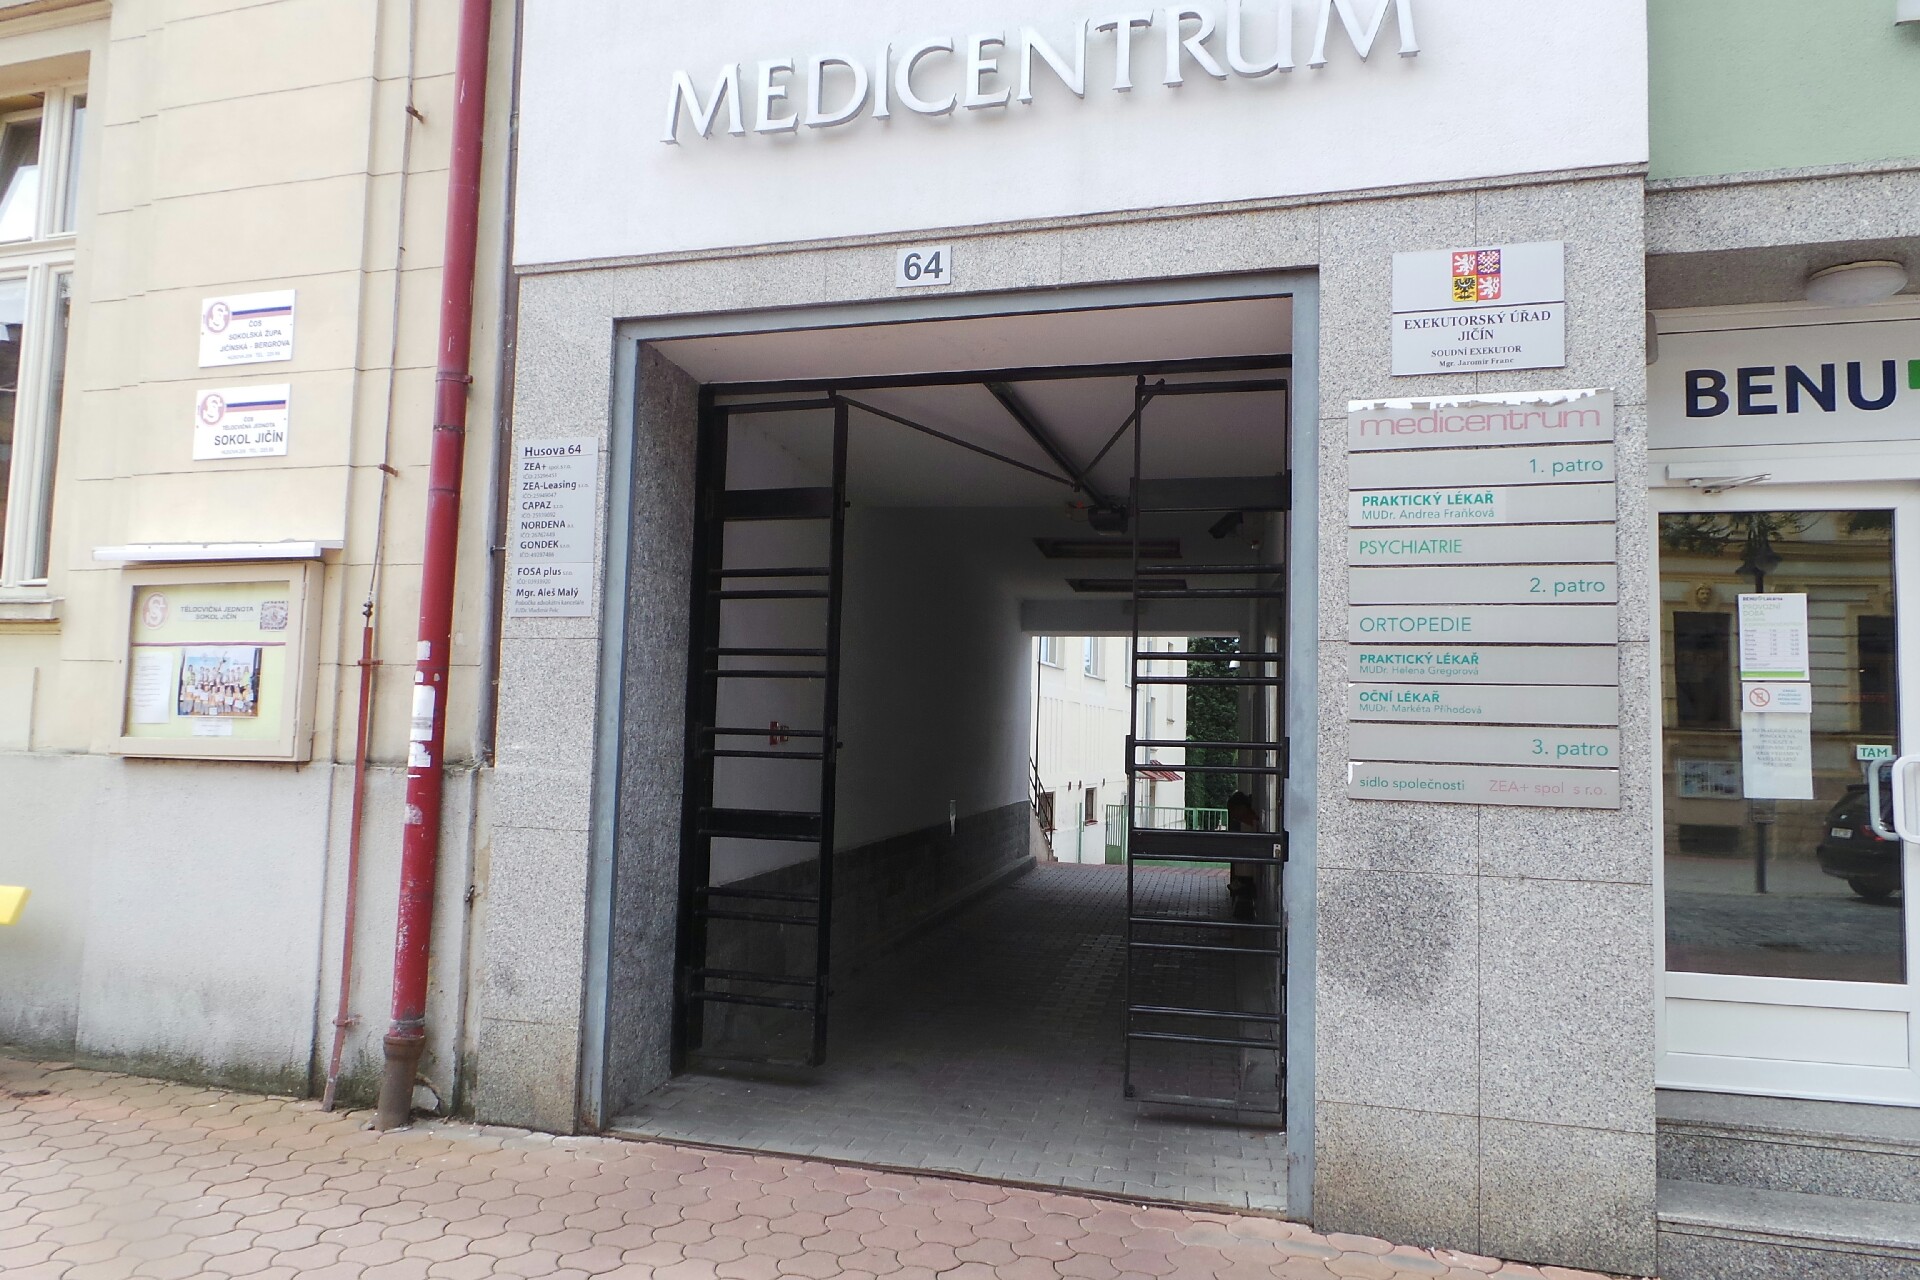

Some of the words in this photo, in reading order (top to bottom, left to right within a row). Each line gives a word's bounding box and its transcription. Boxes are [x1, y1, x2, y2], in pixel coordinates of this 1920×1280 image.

[660, 0, 1421, 145] MEDICENTRUM
[904, 251, 943, 280] 64
[1404, 311, 1507, 330] EXEKUTORSKÝ
[1510, 309, 1551, 324] ÚŘAD
[229, 330, 263, 341] SOKOLSKÁ
[1458, 327, 1494, 341] JIČÍN
[254, 340, 290, 349] BERGROVA
[1431, 347, 1468, 358] SOUDNÍ
[1470, 345, 1521, 356] EXEKUTOR
[1439, 360, 1455, 368] Mgr.
[1458, 358, 1489, 366] Jaromír
[1685, 360, 1897, 418] BENU
[1360, 409, 1600, 436] medicentrum
[214, 434, 251, 446] SOKOL
[255, 430, 283, 443] JIČÍN
[525, 446, 565, 456] Husova
[568, 445, 581, 454] 64
[524, 463, 546, 471] ZEA+
[1529, 458, 1544, 473] 1.
[1552, 458, 1603, 477] patro
[523, 480, 577, 491] ZEA-Leasing
[1362, 492, 1442, 507] PRAKTICKÝ
[1447, 490, 1494, 505] LÉKAŘ
[522, 501, 551, 510] CAPAZ
[1362, 510, 1396, 520] MUDr.
[1399, 509, 1440, 519] Andrea
[1444, 507, 1494, 518] Fraňková
[521, 520, 566, 530] NORDENA
[520, 540, 559, 549] GONDEK
[1359, 539, 1463, 555] PSYCHIATRIE
[518, 567, 541, 576] FOSA
[543, 567, 562, 577] plus
[516, 588, 536, 598] Mgr.
[538, 588, 555, 596] Aleš
[558, 587, 578, 598] Malý
[1529, 578, 1546, 593] 2.
[1554, 578, 1606, 597] patro
[1360, 617, 1472, 632] ORTOPEDIE
[1360, 651, 1432, 664] PRAKTICKÝ
[1436, 652, 1479, 665] LÉKAŘ
[1360, 665, 1389, 674] MUDr.
[1392, 666, 1425, 675] Helena
[1428, 667, 1479, 677] Gregorová
[1360, 690, 1393, 702] OČNÍ
[1397, 691, 1440, 703] LÉKAŘ
[1360, 704, 1389, 712] MUDr.
[1391, 704, 1431, 713] Markéta
[1434, 705, 1482, 715] Příhodová
[1532, 739, 1548, 755] 3.
[1556, 740, 1608, 758] patro
[1860, 748, 1888, 758] TAM
[1360, 777, 1389, 788] sídlo
[1393, 777, 1465, 792] společnosti
[1489, 780, 1529, 793] ZEA+
[1573, 786, 1579, 794] s
[1585, 785, 1607, 796] r.o.
